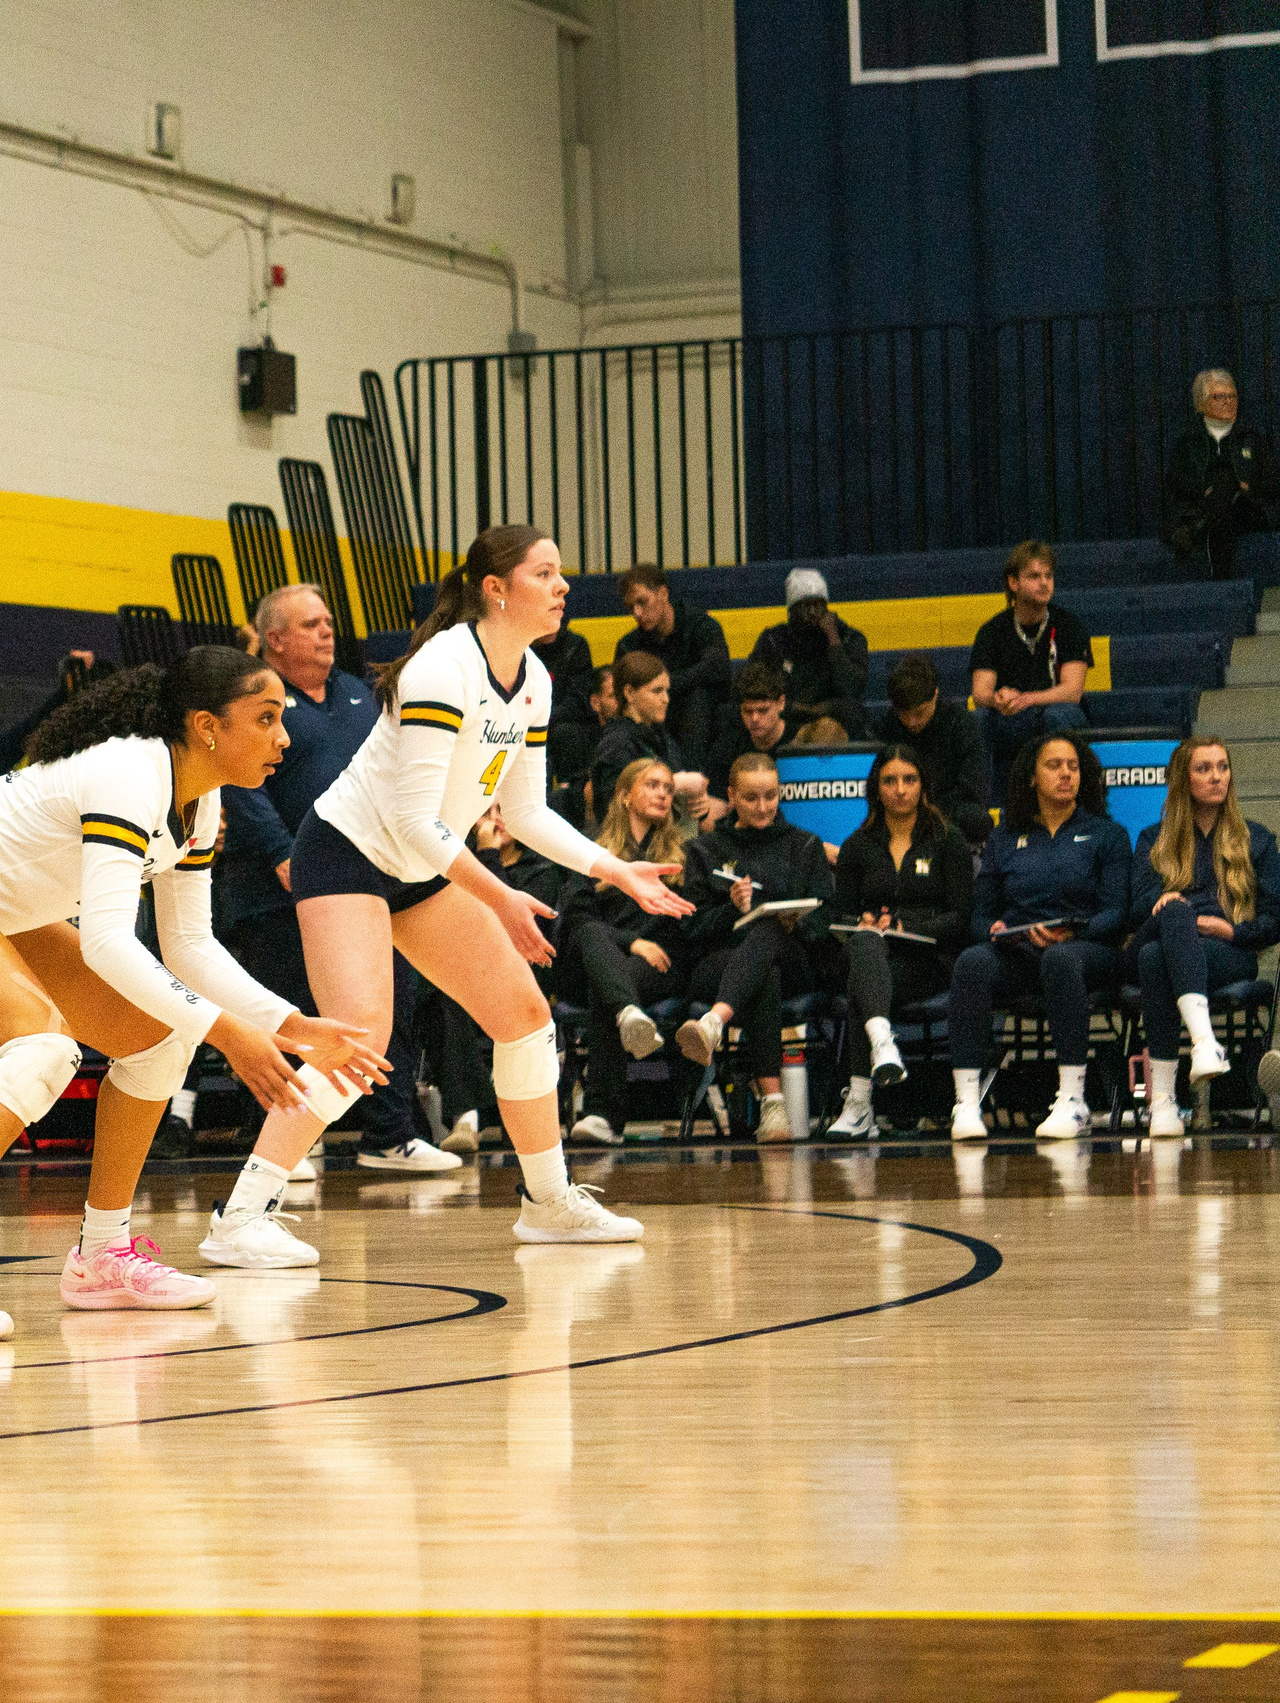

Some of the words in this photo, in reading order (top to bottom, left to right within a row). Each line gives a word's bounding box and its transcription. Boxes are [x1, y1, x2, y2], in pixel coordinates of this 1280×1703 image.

[480, 719, 524, 744] Humber
[479, 750, 508, 796] 4
[1105, 766, 1167, 786] ERADE
